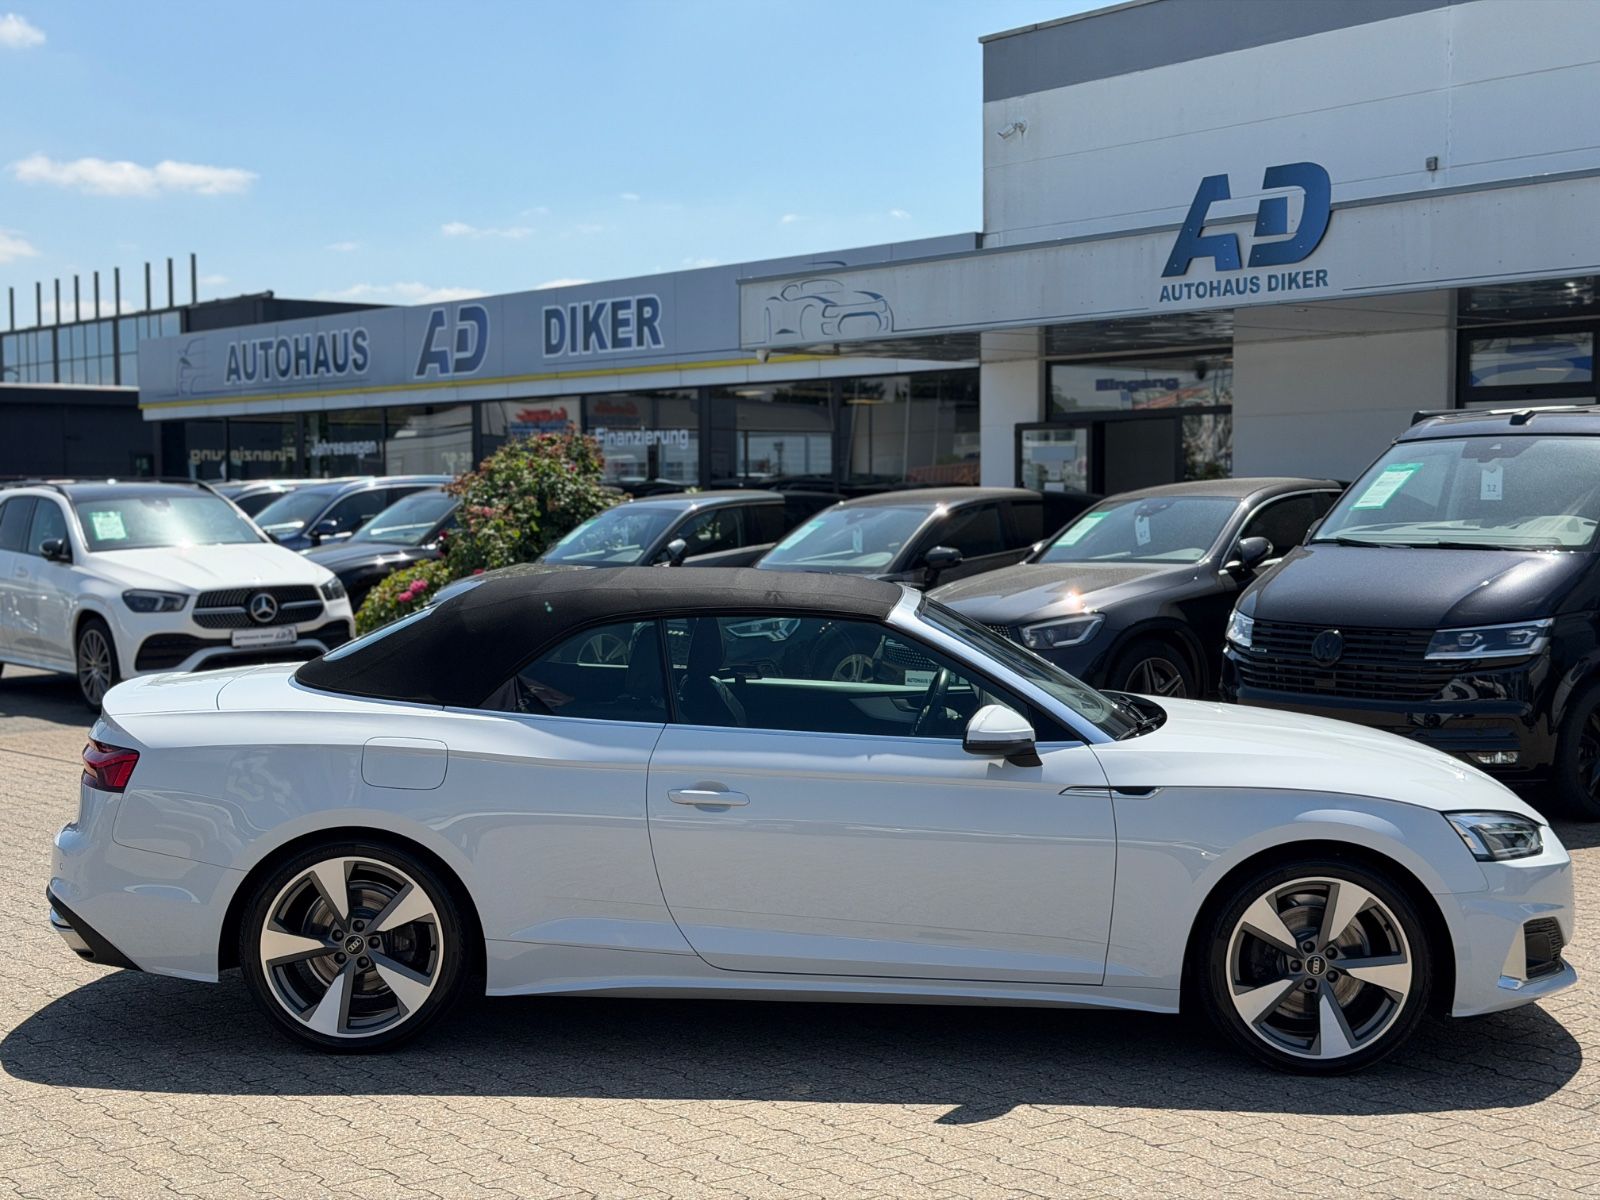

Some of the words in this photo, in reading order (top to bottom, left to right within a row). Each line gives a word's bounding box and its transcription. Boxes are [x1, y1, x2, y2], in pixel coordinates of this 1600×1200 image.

[1161, 162, 1332, 278] AD
[1159, 275, 1260, 303] AUTOHAUS
[1267, 269, 1328, 292] DIKER
[225, 327, 369, 384] AUTOHAUS
[543, 294, 664, 357] DIKER
[595, 427, 689, 449] Finanzierung
